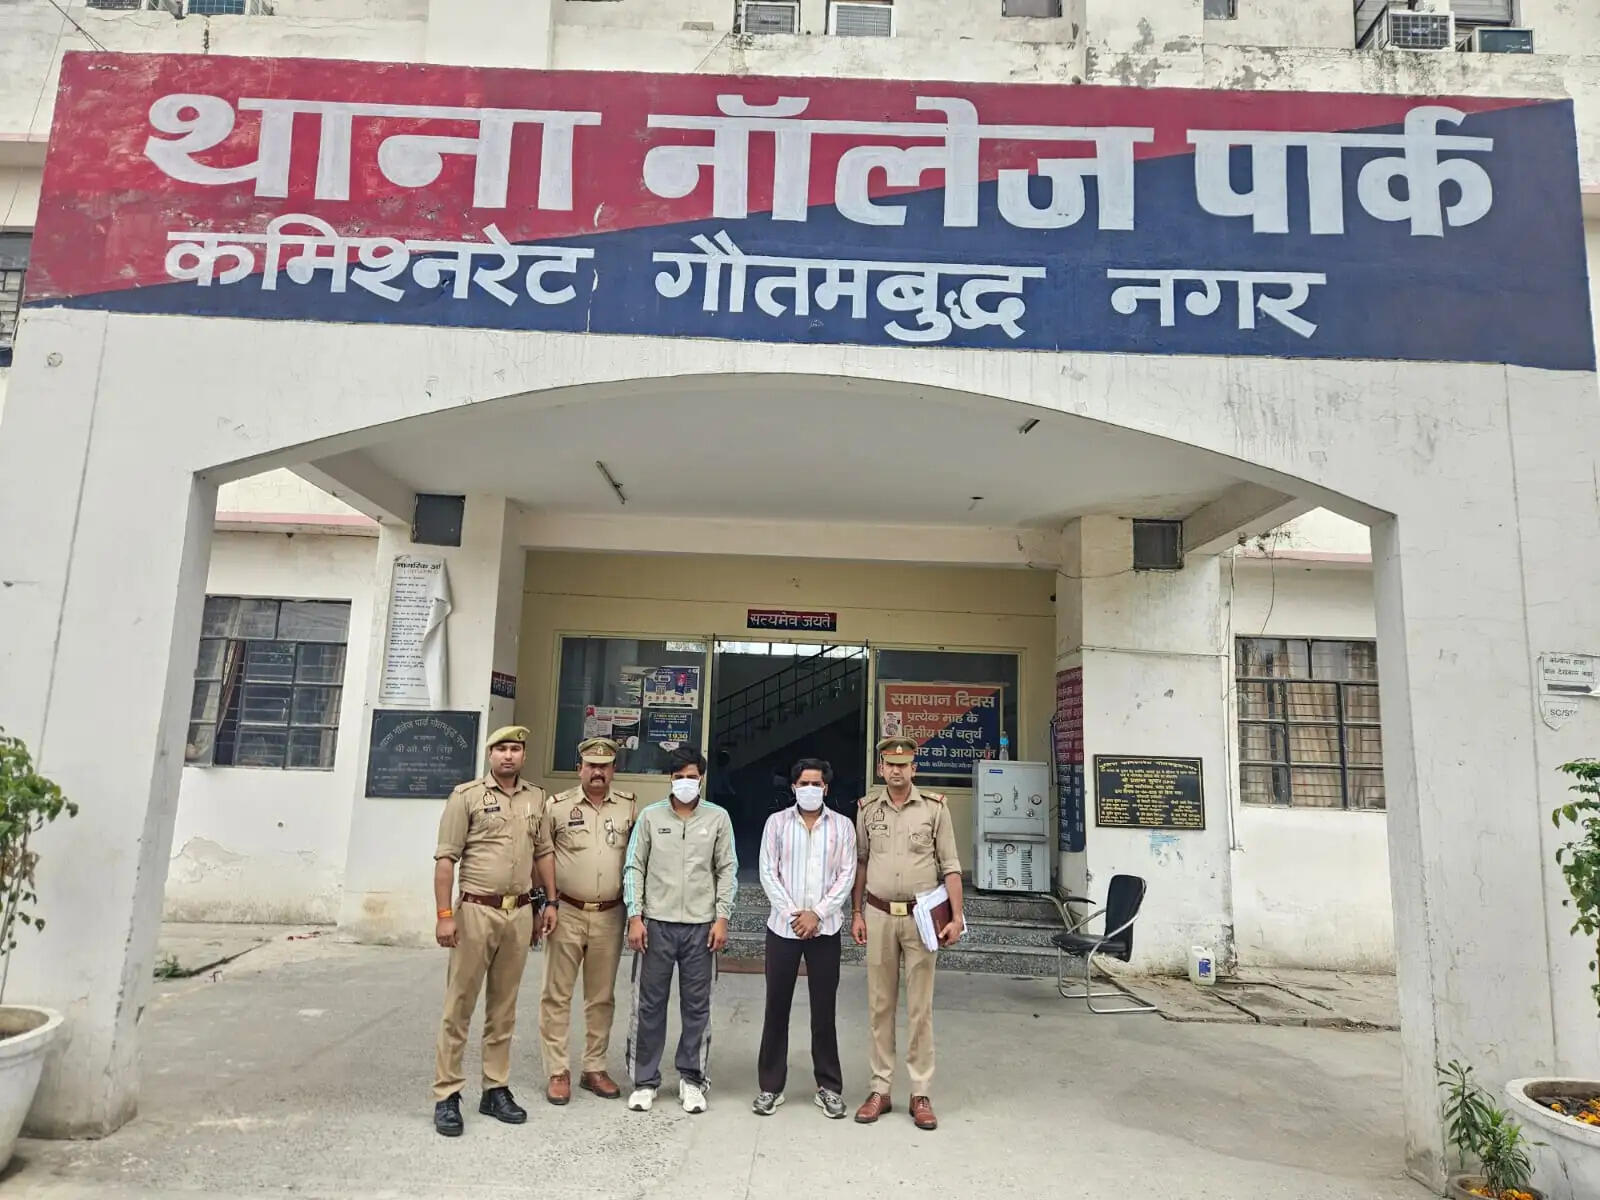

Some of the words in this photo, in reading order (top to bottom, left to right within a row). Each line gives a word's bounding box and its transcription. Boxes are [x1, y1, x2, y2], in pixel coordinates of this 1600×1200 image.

[144, 93, 602, 211] थाना
[642, 94, 1154, 231] नॉलेज
[1186, 105, 1493, 237] पार्क
[165, 213, 594, 306] कमिश्नरेट
[652, 230, 1046, 343] गौतमबुद्ध
[1107, 268, 1326, 338] नगर
[750, 612, 801, 627] सत्यमेव
[802, 613, 830, 628] जयते
[890, 692, 950, 707] समाधान
[955, 691, 996, 708] दिवस
[907, 709, 939, 723] प्रत्येक
[966, 711, 980, 723] के
[938, 726, 954, 739] एवं
[931, 745, 947, 757] को
